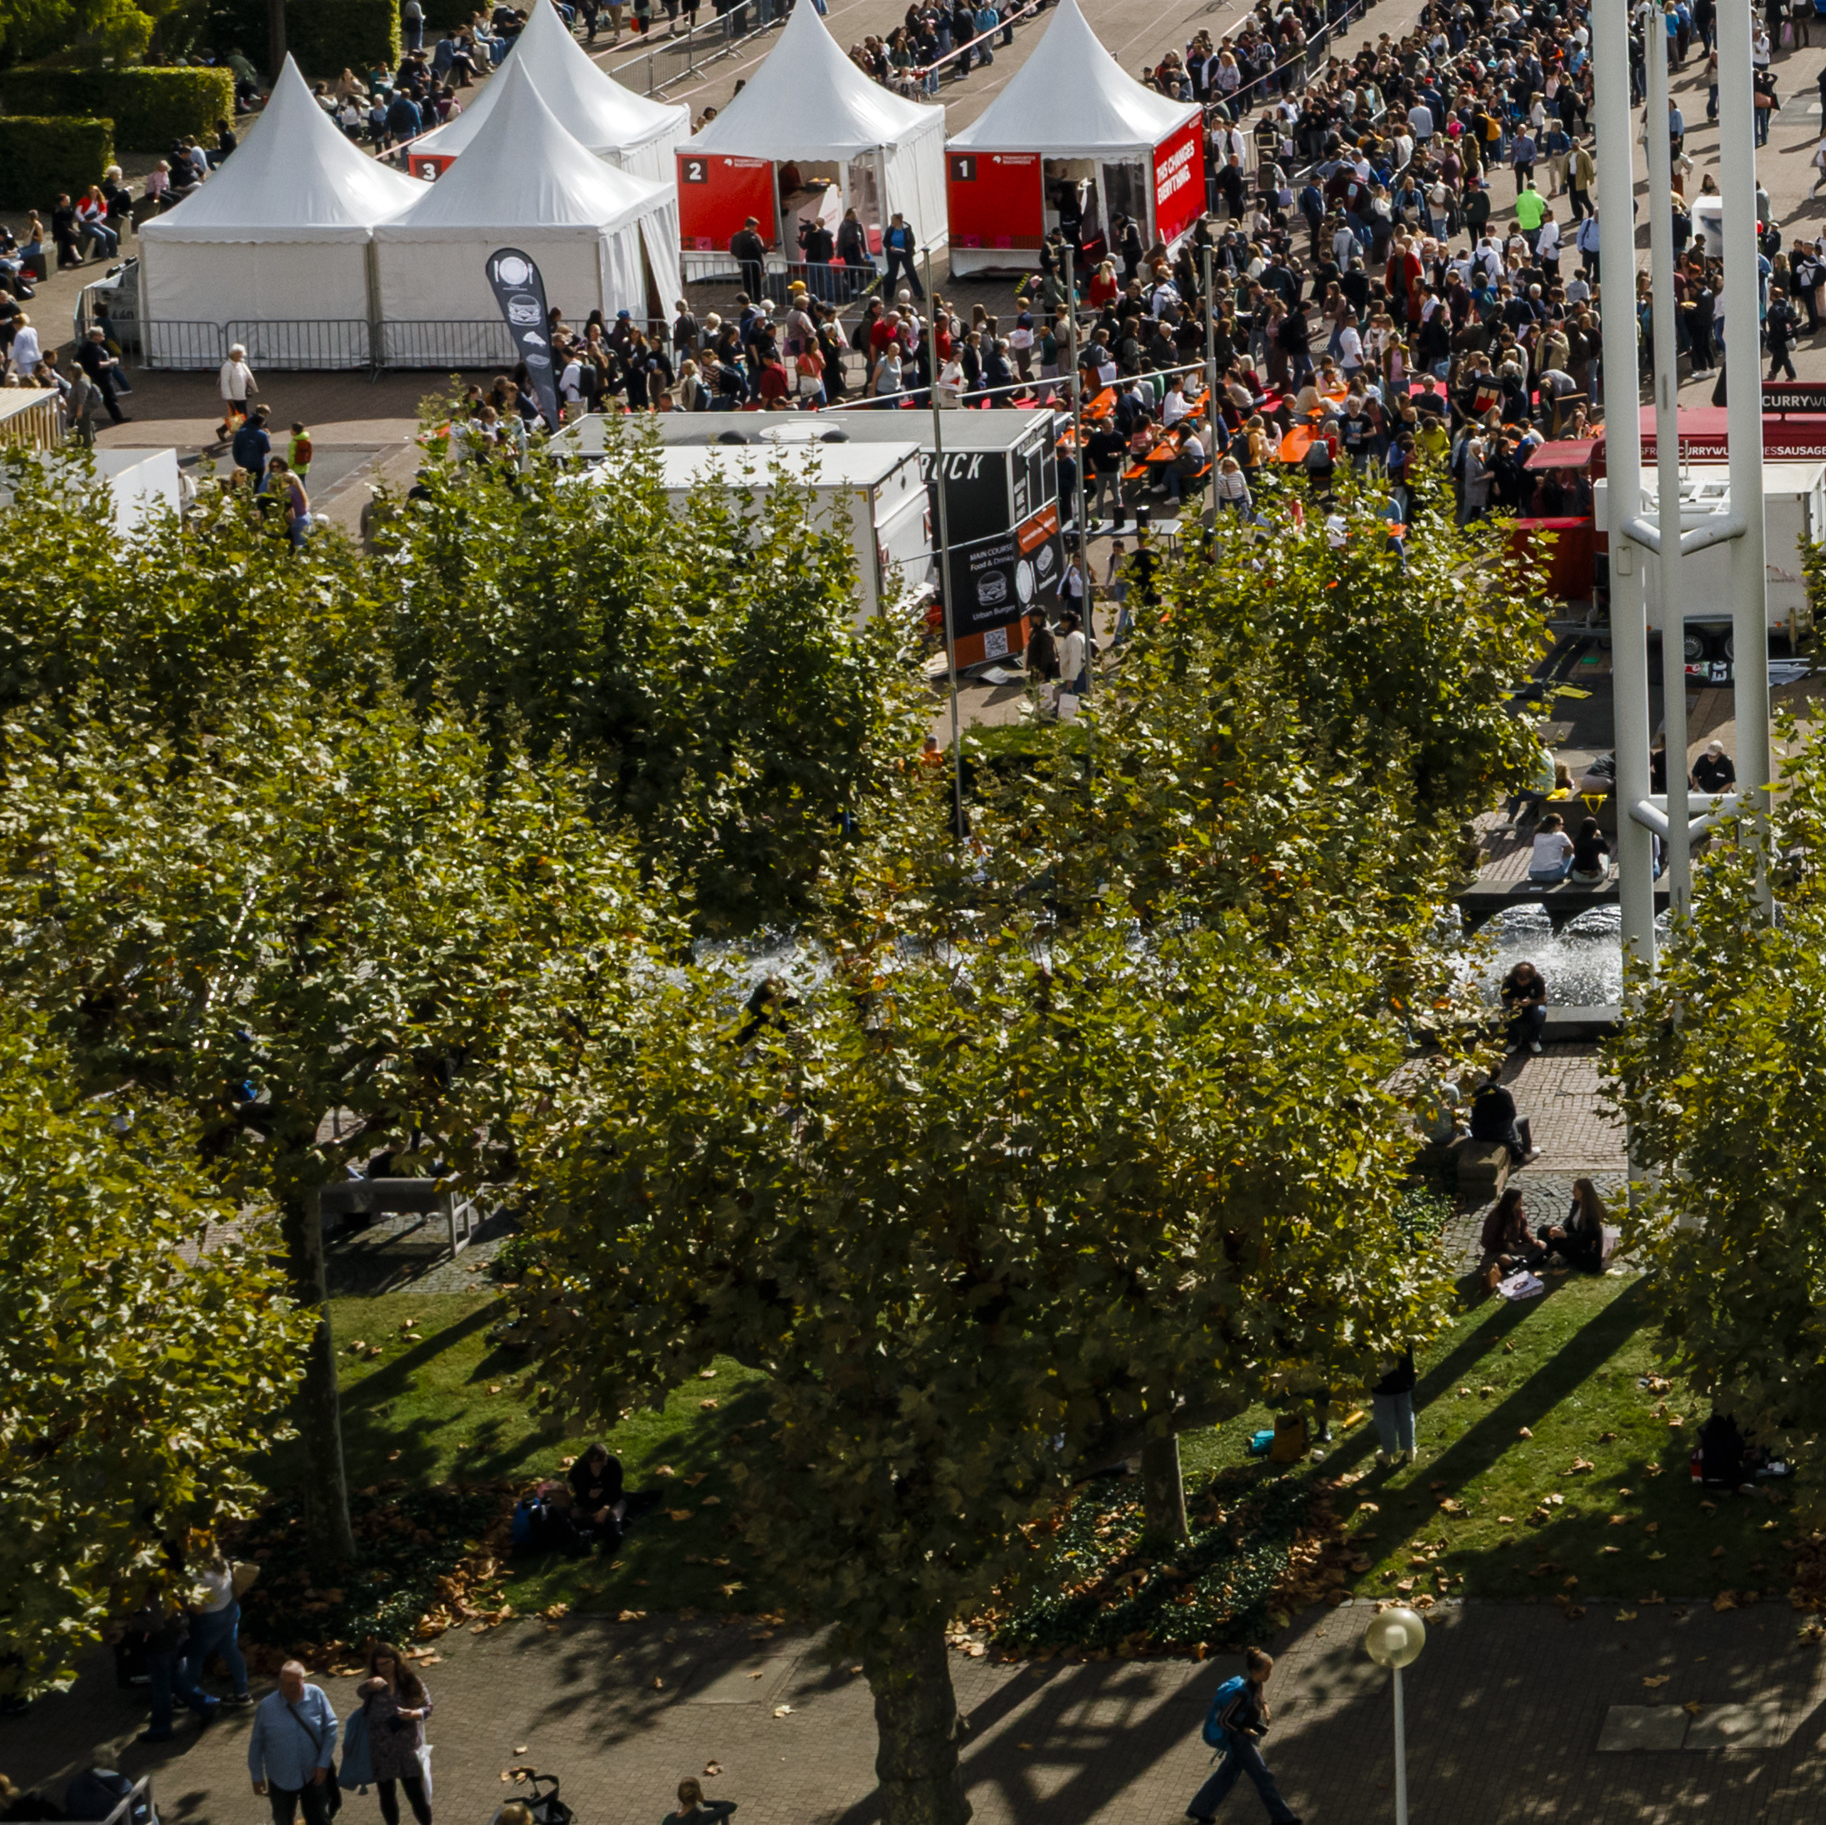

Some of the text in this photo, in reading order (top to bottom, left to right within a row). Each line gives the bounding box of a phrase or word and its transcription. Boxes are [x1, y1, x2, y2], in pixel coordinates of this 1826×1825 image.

[958, 162, 969, 178] 1
[1155, 139, 1196, 185] THIS CHANGES
[422, 163, 437, 180] 3
[688, 163, 702, 180] 2
[970, 549, 987, 562] MAIN
[970, 561, 986, 572] Food
[972, 603, 1017, 621] Urban Burger
